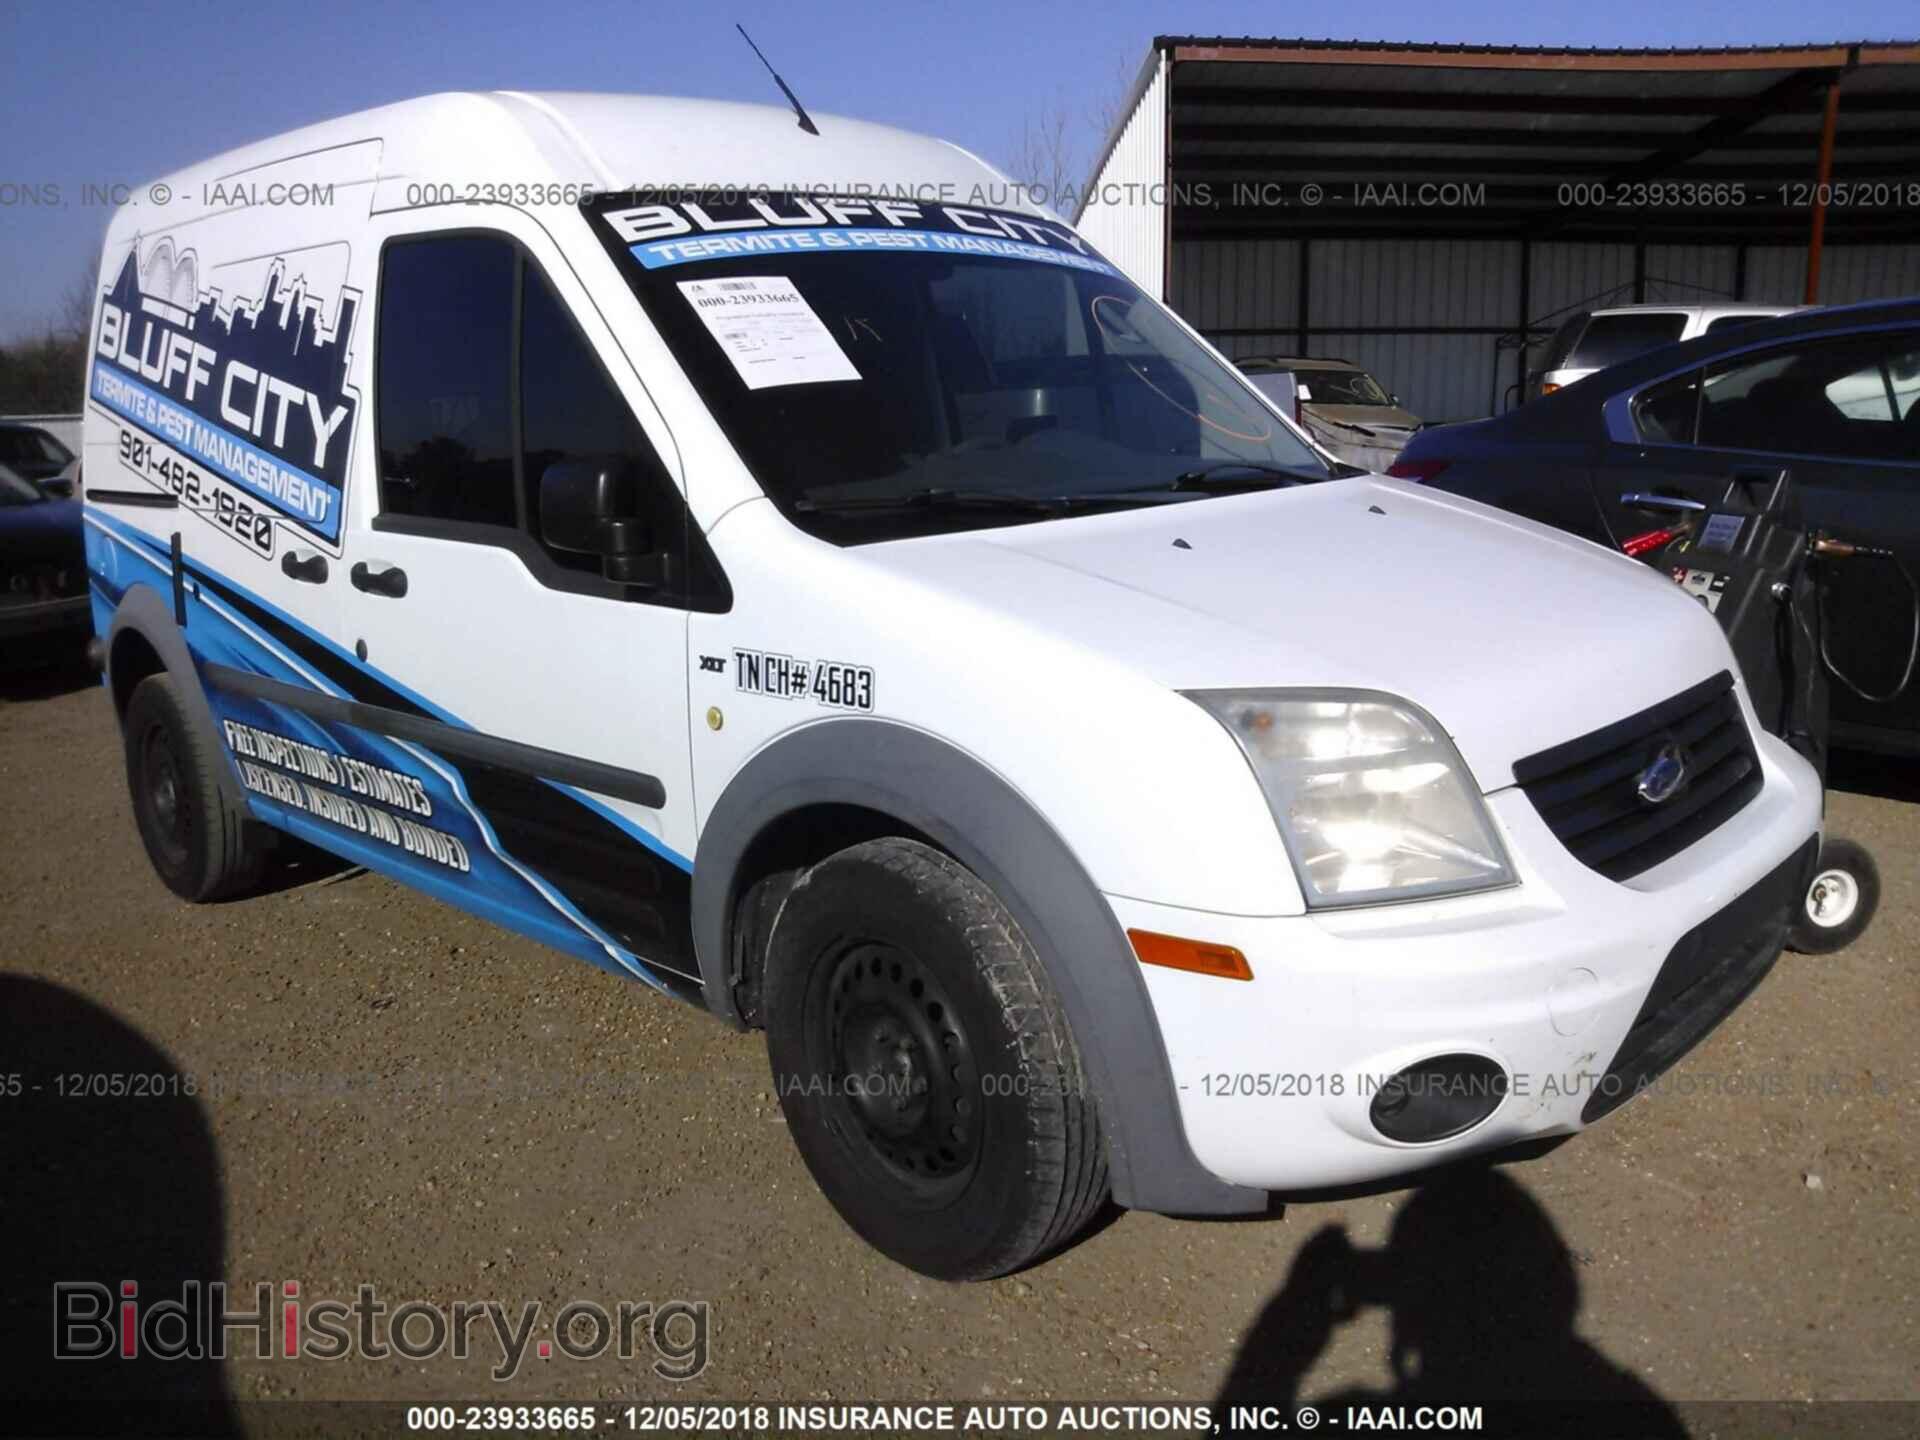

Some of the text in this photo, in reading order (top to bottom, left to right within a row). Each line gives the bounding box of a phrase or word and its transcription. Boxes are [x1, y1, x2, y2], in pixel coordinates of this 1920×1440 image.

[601, 197, 1090, 256] BLUFF CITY
[649, 231, 820, 262] TERMITE
[820, 231, 849, 248] &
[848, 231, 933, 249] PEST
[98, 302, 349, 469] BLUFF CITY
[97, 368, 147, 418] TERMITE
[157, 402, 194, 446] PEST
[194, 423, 330, 522] MANAGEMENT
[120, 428, 272, 552] 901-482-1920
[813, 664, 872, 709] 4683
[340, 756, 432, 817] ESTIMATES
[362, 804, 400, 846] AND
[394, 815, 470, 873] BONDED
